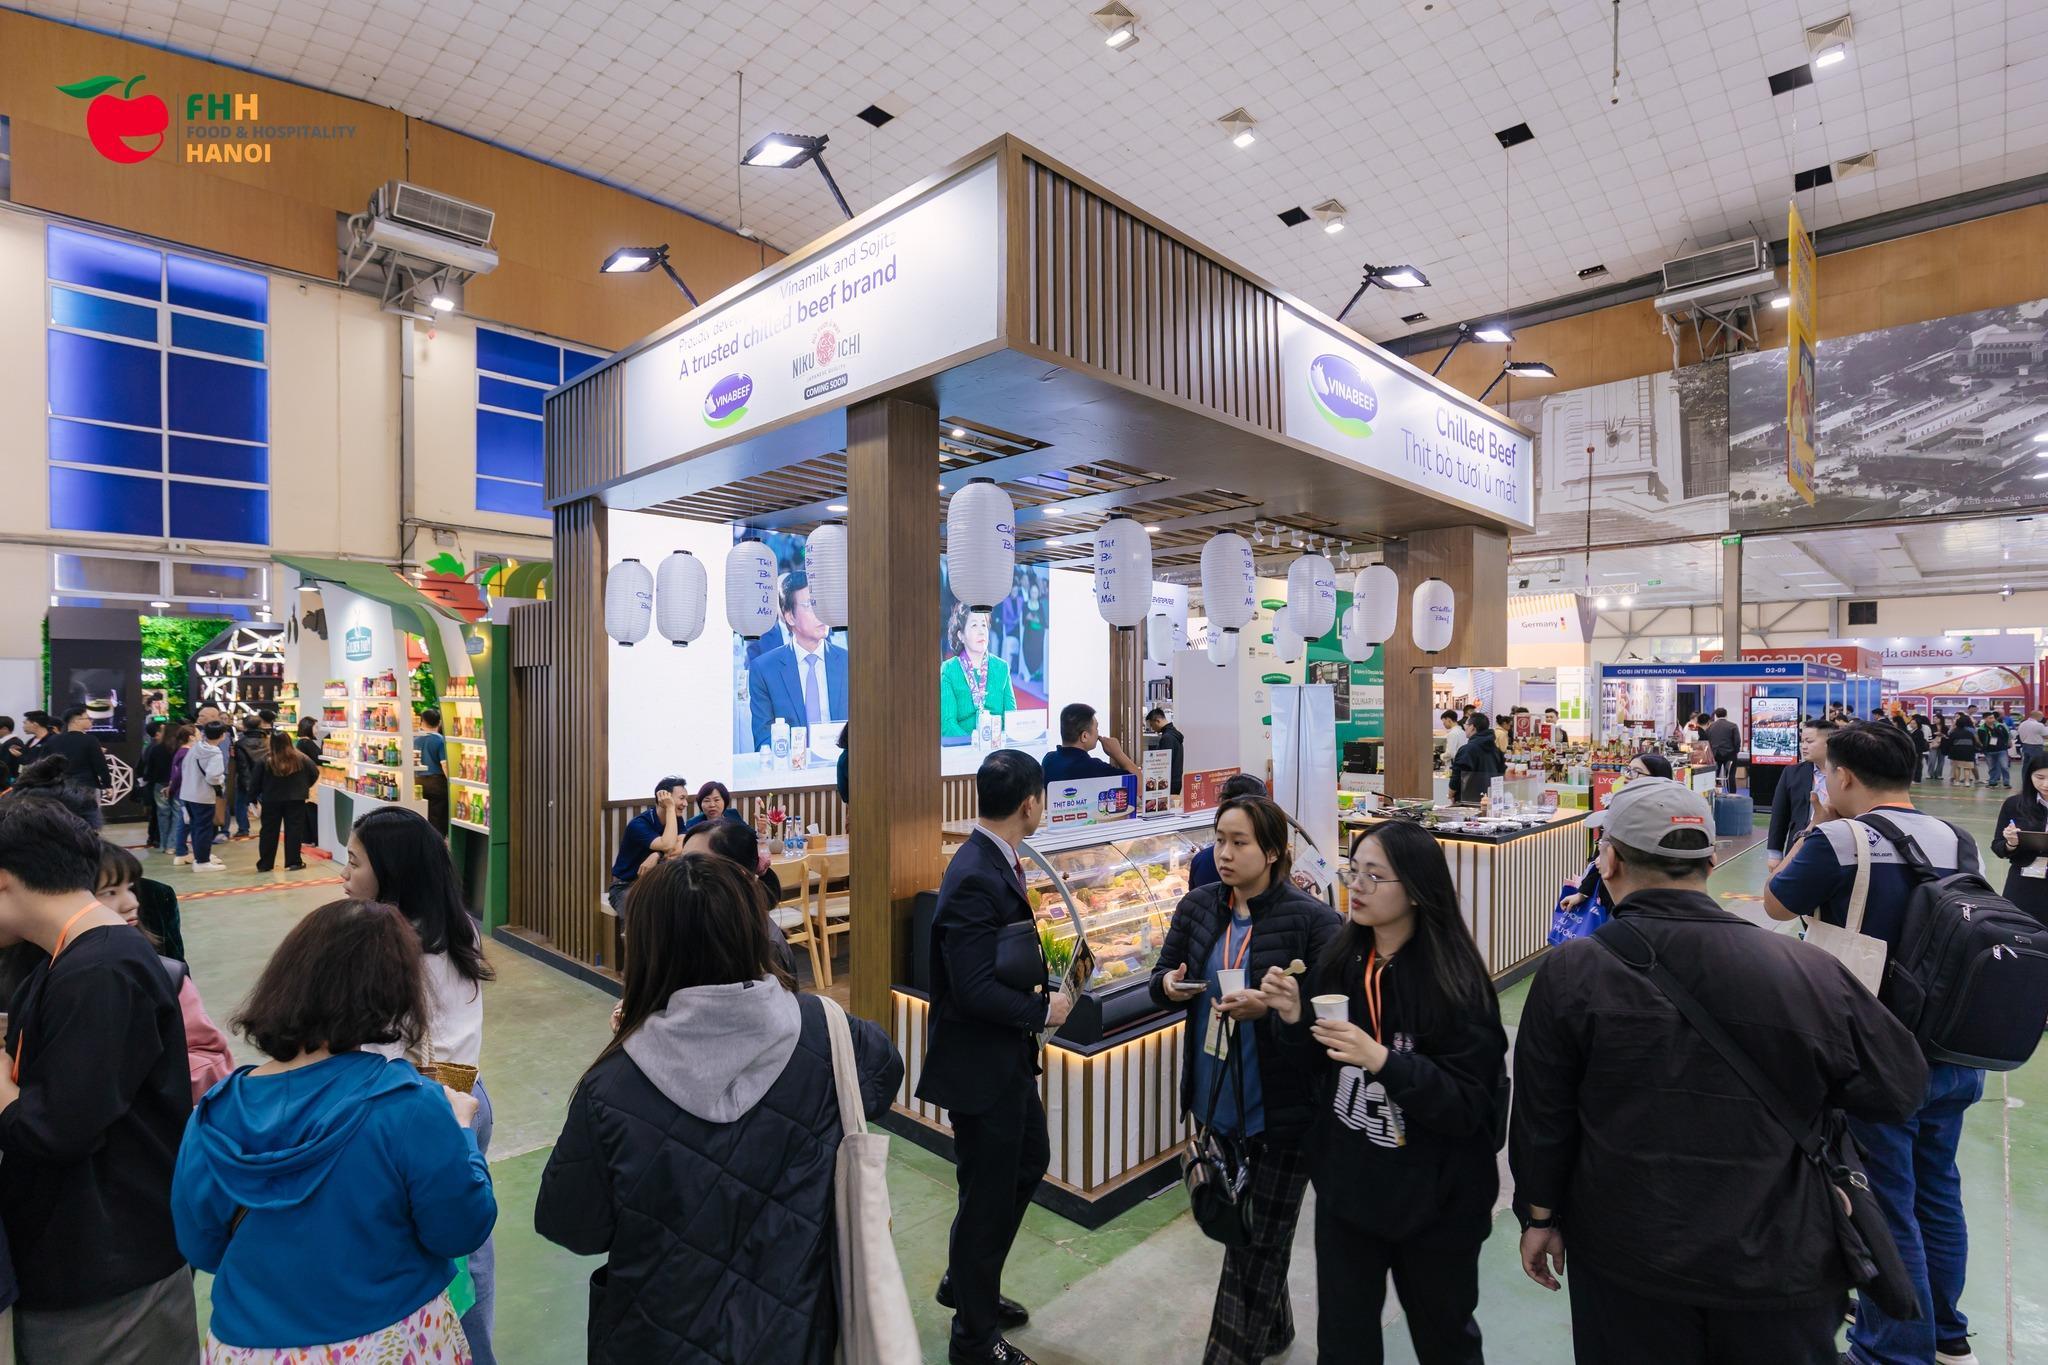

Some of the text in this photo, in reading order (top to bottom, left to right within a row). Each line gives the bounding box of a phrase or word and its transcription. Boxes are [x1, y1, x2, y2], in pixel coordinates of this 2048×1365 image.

[780, 267, 830, 299] Vinamilk
[833, 248, 856, 275] and
[860, 231, 897, 262] Sojitz
[679, 360, 689, 380] A
[692, 338, 739, 374] trusted
[743, 308, 792, 349] chilled
[797, 286, 836, 324] beef
[842, 254, 897, 304] brand
[793, 352, 815, 379] NIKU
[838, 333, 860, 358] ICHI
[716, 384, 750, 408] VINABEEF
[806, 375, 848, 398] COMING SOON
[1328, 376, 1375, 411] VINABEEF
[1436, 405, 1516, 468] Chilled Beef
[1401, 427, 1433, 476] Thịt
[1436, 448, 1453, 478] bò
[1457, 459, 1481, 488] tươi
[1495, 473, 1517, 504] mát
[1521, 620, 1558, 630] Germany
[1900, 649, 1953, 658] GINSENG
